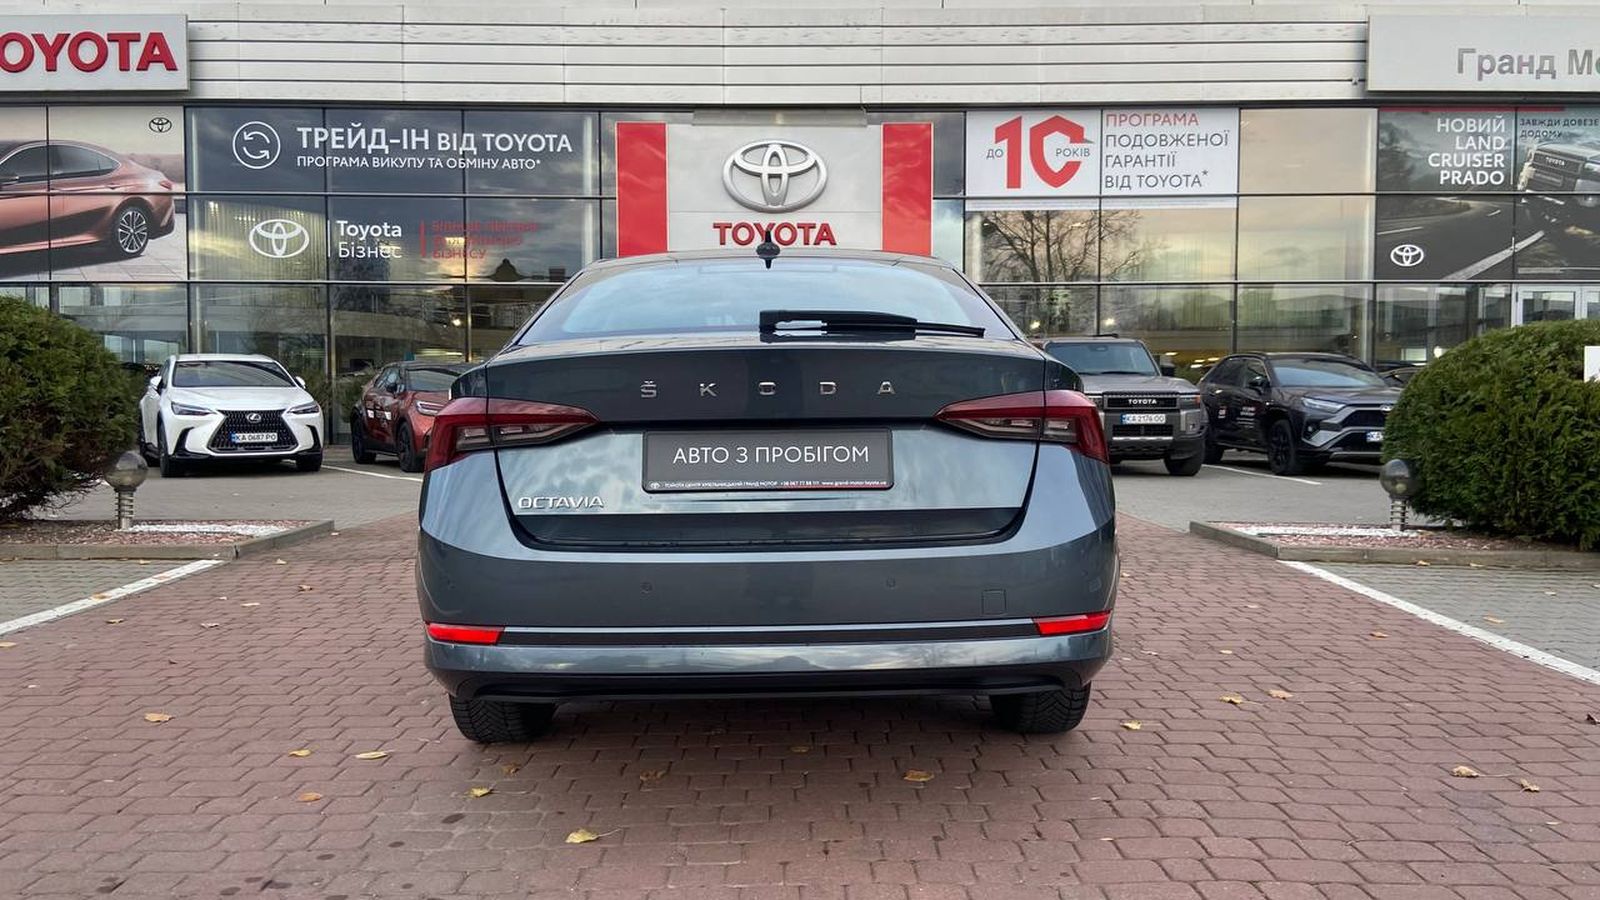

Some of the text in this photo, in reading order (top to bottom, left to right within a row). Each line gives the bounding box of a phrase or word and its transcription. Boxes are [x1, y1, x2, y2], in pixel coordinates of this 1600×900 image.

[1457, 48, 1557, 81] Гранд
[1105, 113, 1199, 127] ПРОГРАМА
[1436, 115, 1505, 133] НОВИЙ
[1519, 118, 1561, 127] ЗАВЖДИ
[296, 122, 573, 155] ТРЕЙД-ІН ВІД TOYOTA
[1105, 130, 1230, 149] ПОДОВЖЕНОЇ
[1455, 135, 1505, 150] LAND
[986, 148, 1004, 159] ДО
[1055, 147, 1091, 158] РОКІВ
[1105, 151, 1178, 169] ГАРАНТІЇ
[1428, 152, 1505, 168] CRUISER
[296, 155, 369, 168] ПРОГРАМА
[372, 156, 426, 169] ВИКУПУ
[428, 157, 444, 169] ТА
[446, 157, 500, 170] ОБМІНУ
[1104, 175, 1132, 190] ВІД
[1439, 170, 1505, 185] PRADO
[335, 220, 403, 241] Toyota
[713, 221, 837, 246] TOYOTA
[338, 241, 403, 259] Бізнес
[432, 248, 487, 259] БІЗНСУ
[640, 380, 895, 398] ŠKODA
[672, 445, 869, 464] АВТО З ПРОБІГОМ
[518, 495, 605, 509] OCTAVIA
